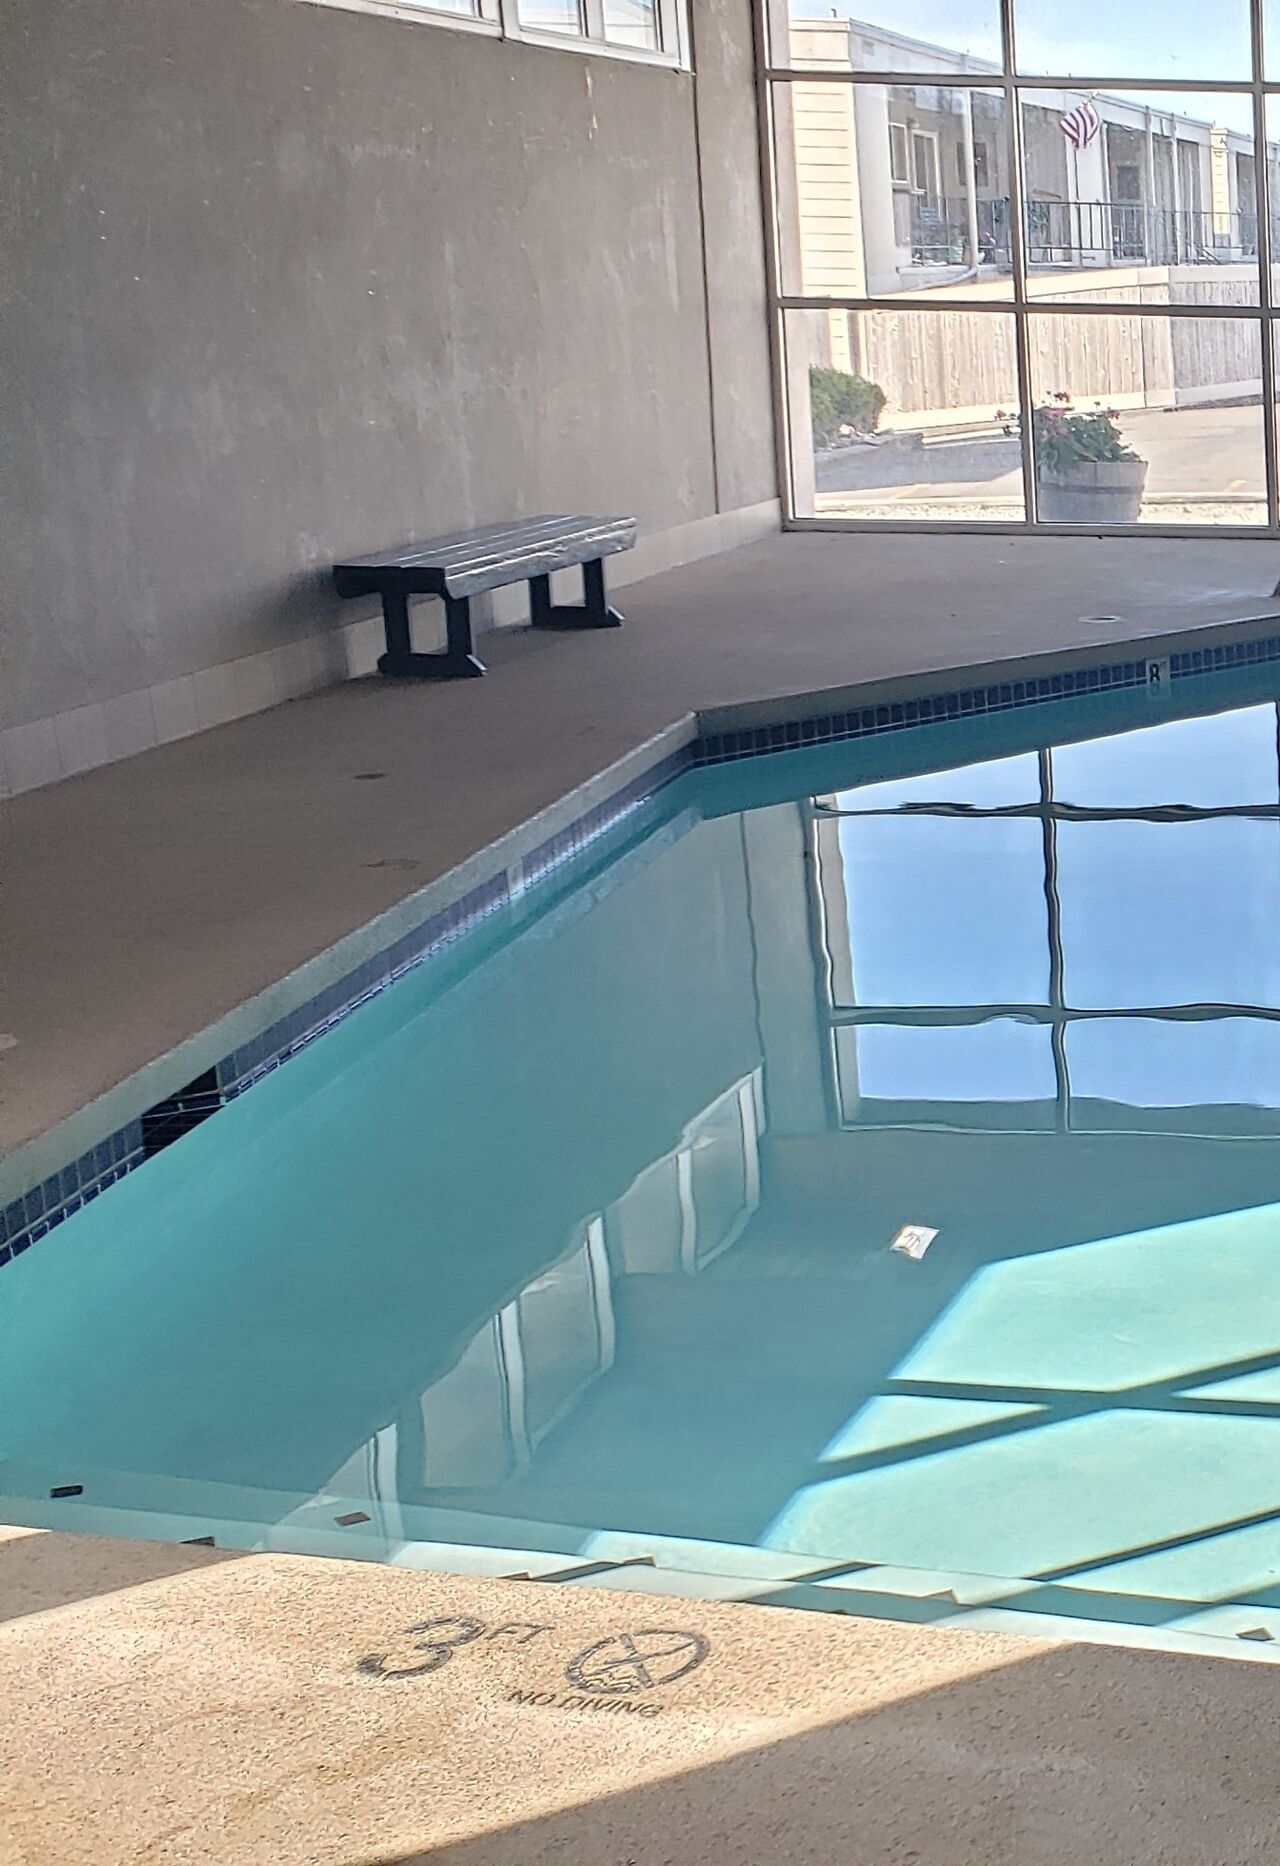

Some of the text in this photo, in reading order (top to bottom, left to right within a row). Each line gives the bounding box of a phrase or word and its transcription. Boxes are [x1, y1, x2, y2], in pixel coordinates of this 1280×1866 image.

[355, 1615, 556, 1681] 3 FT
[506, 1690, 664, 1718] NO DIVING
